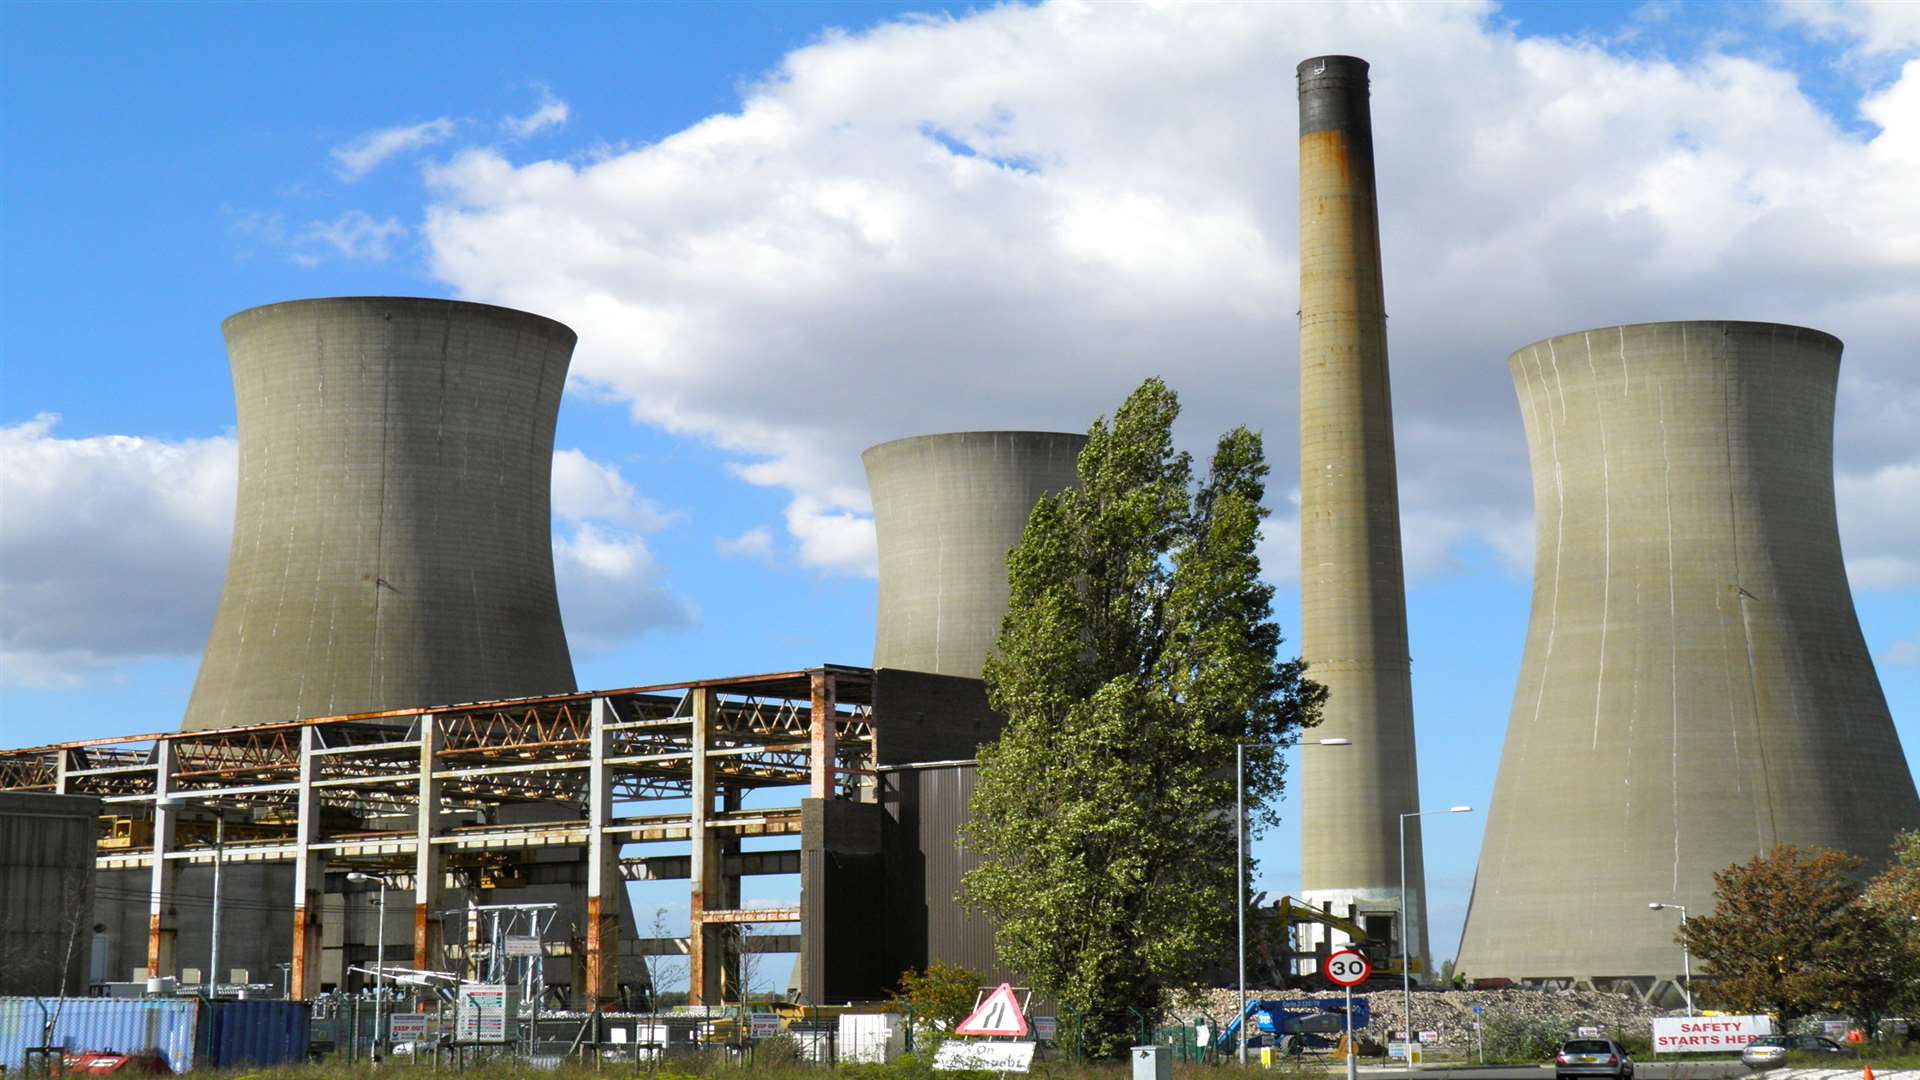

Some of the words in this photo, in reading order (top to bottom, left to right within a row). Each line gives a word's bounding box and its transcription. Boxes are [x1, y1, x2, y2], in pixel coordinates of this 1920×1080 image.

[1332, 961, 1363, 975] 30
[1681, 1023, 1742, 1033] SAFETY
[1659, 1035, 1720, 1046] STARTS
[1725, 1034, 1757, 1044] HER
